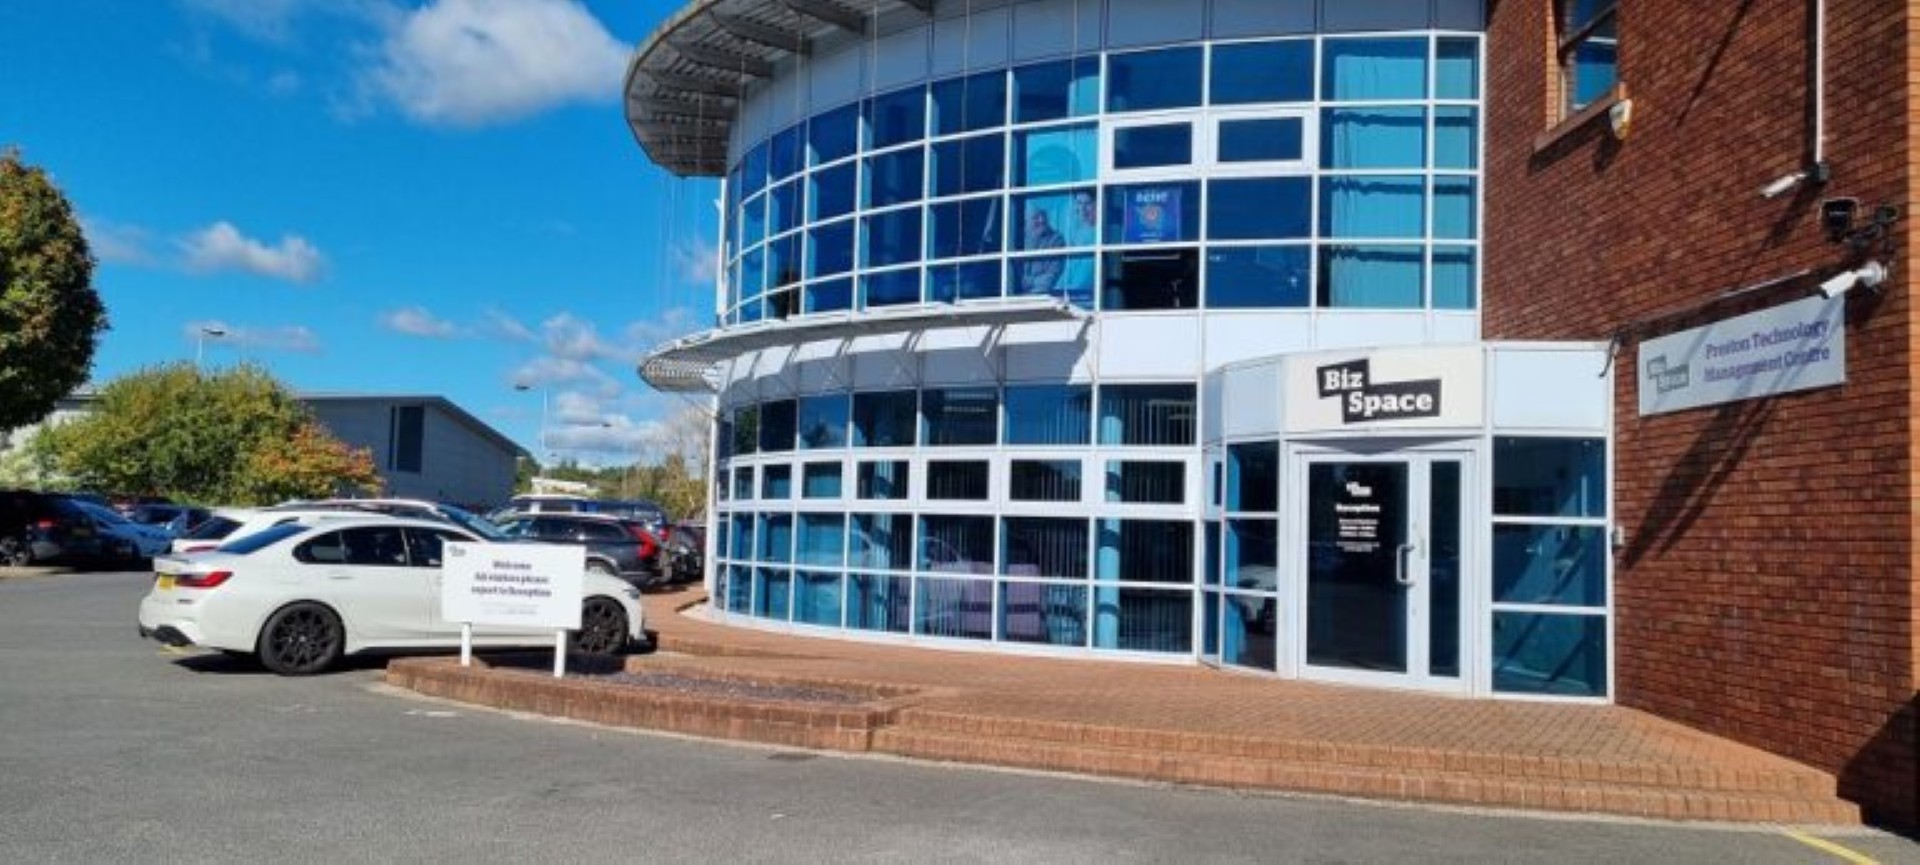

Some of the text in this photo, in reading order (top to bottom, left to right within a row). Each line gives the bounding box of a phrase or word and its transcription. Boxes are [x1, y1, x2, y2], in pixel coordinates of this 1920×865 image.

[1706, 320, 1829, 359] Preston Technology
[1704, 347, 1830, 382] Management Centre
[1324, 368, 1363, 390] Biz
[1348, 391, 1433, 417] Space
[493, 560, 532, 570] Welcome
